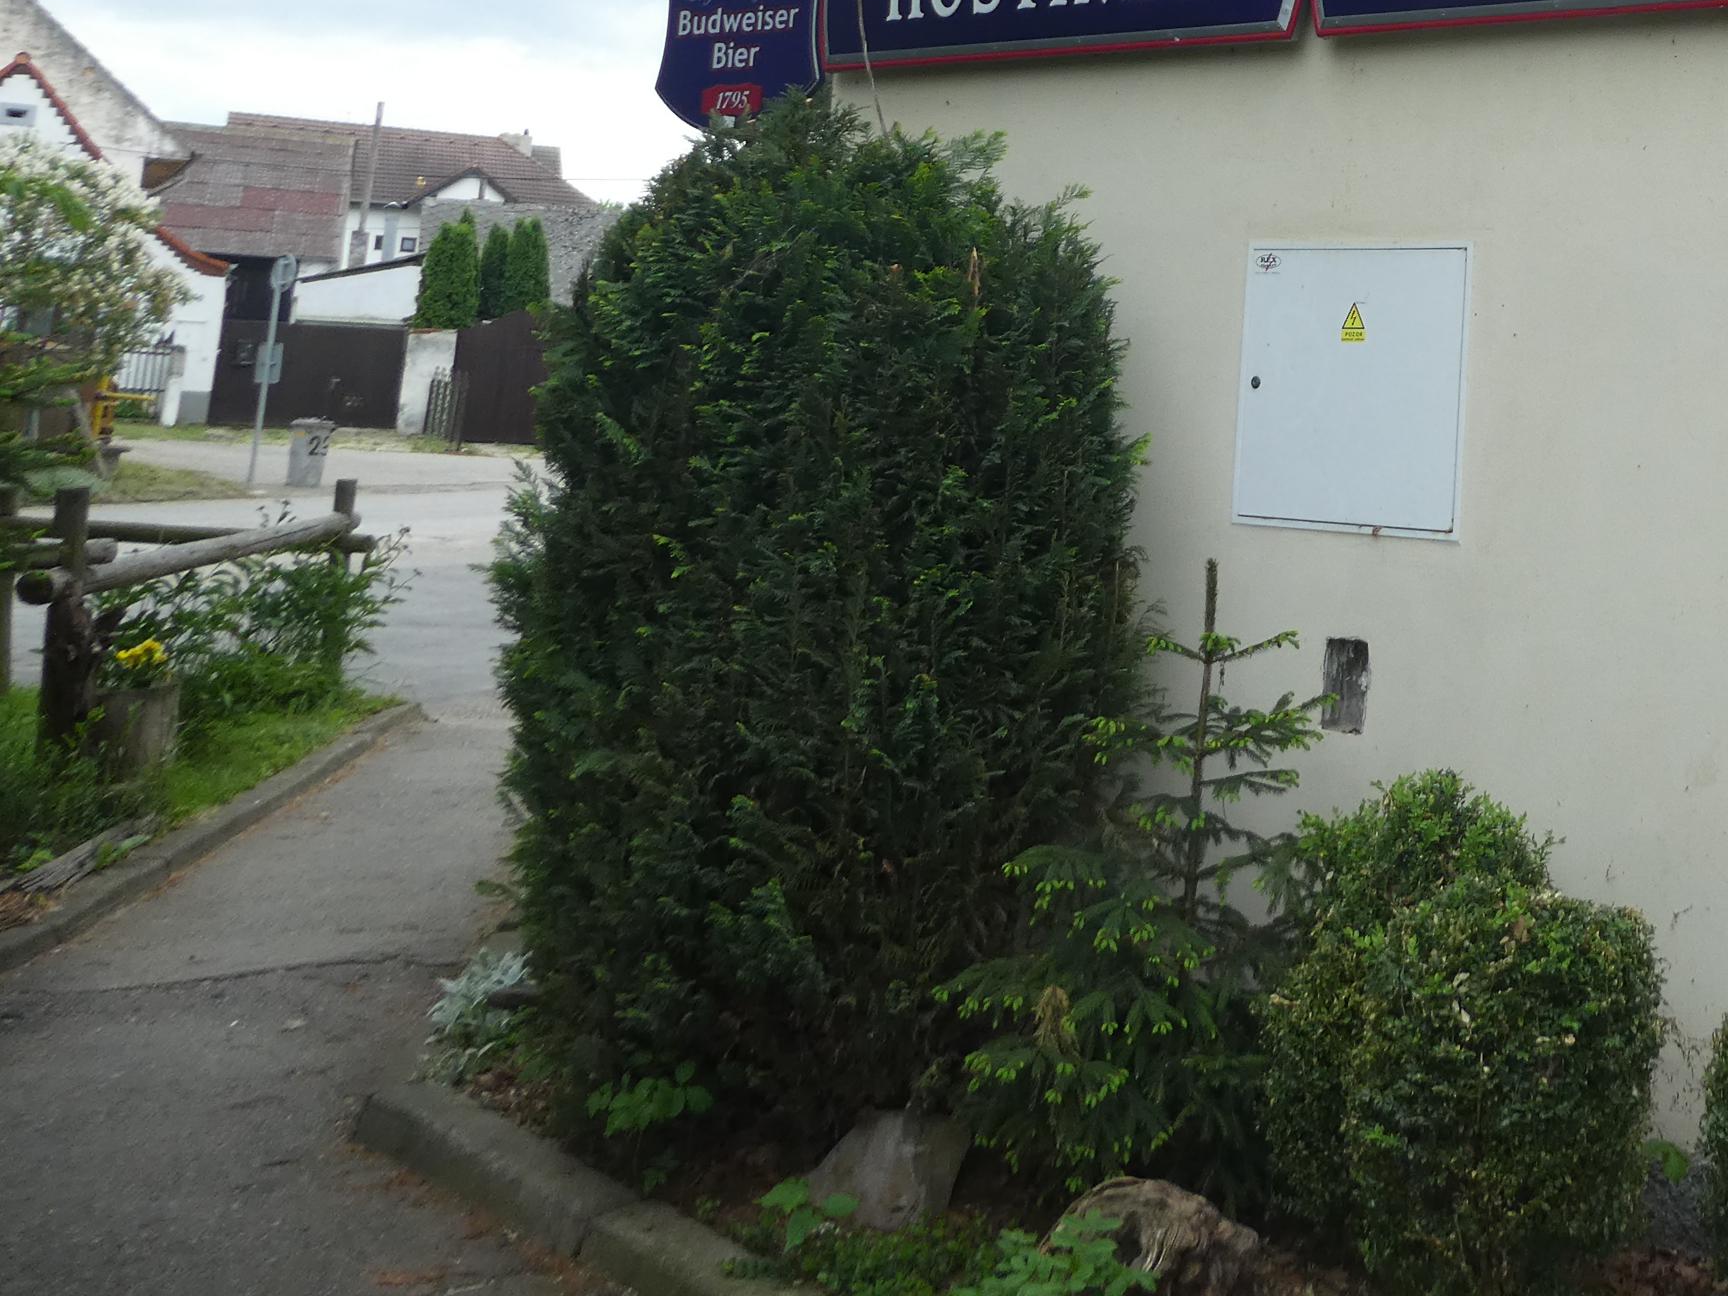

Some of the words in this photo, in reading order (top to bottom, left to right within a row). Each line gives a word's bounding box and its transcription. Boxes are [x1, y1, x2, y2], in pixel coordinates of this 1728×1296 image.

[678, 5, 800, 36] Budweiser
[712, 41, 760, 69] Bier
[715, 90, 750, 114] 1795
